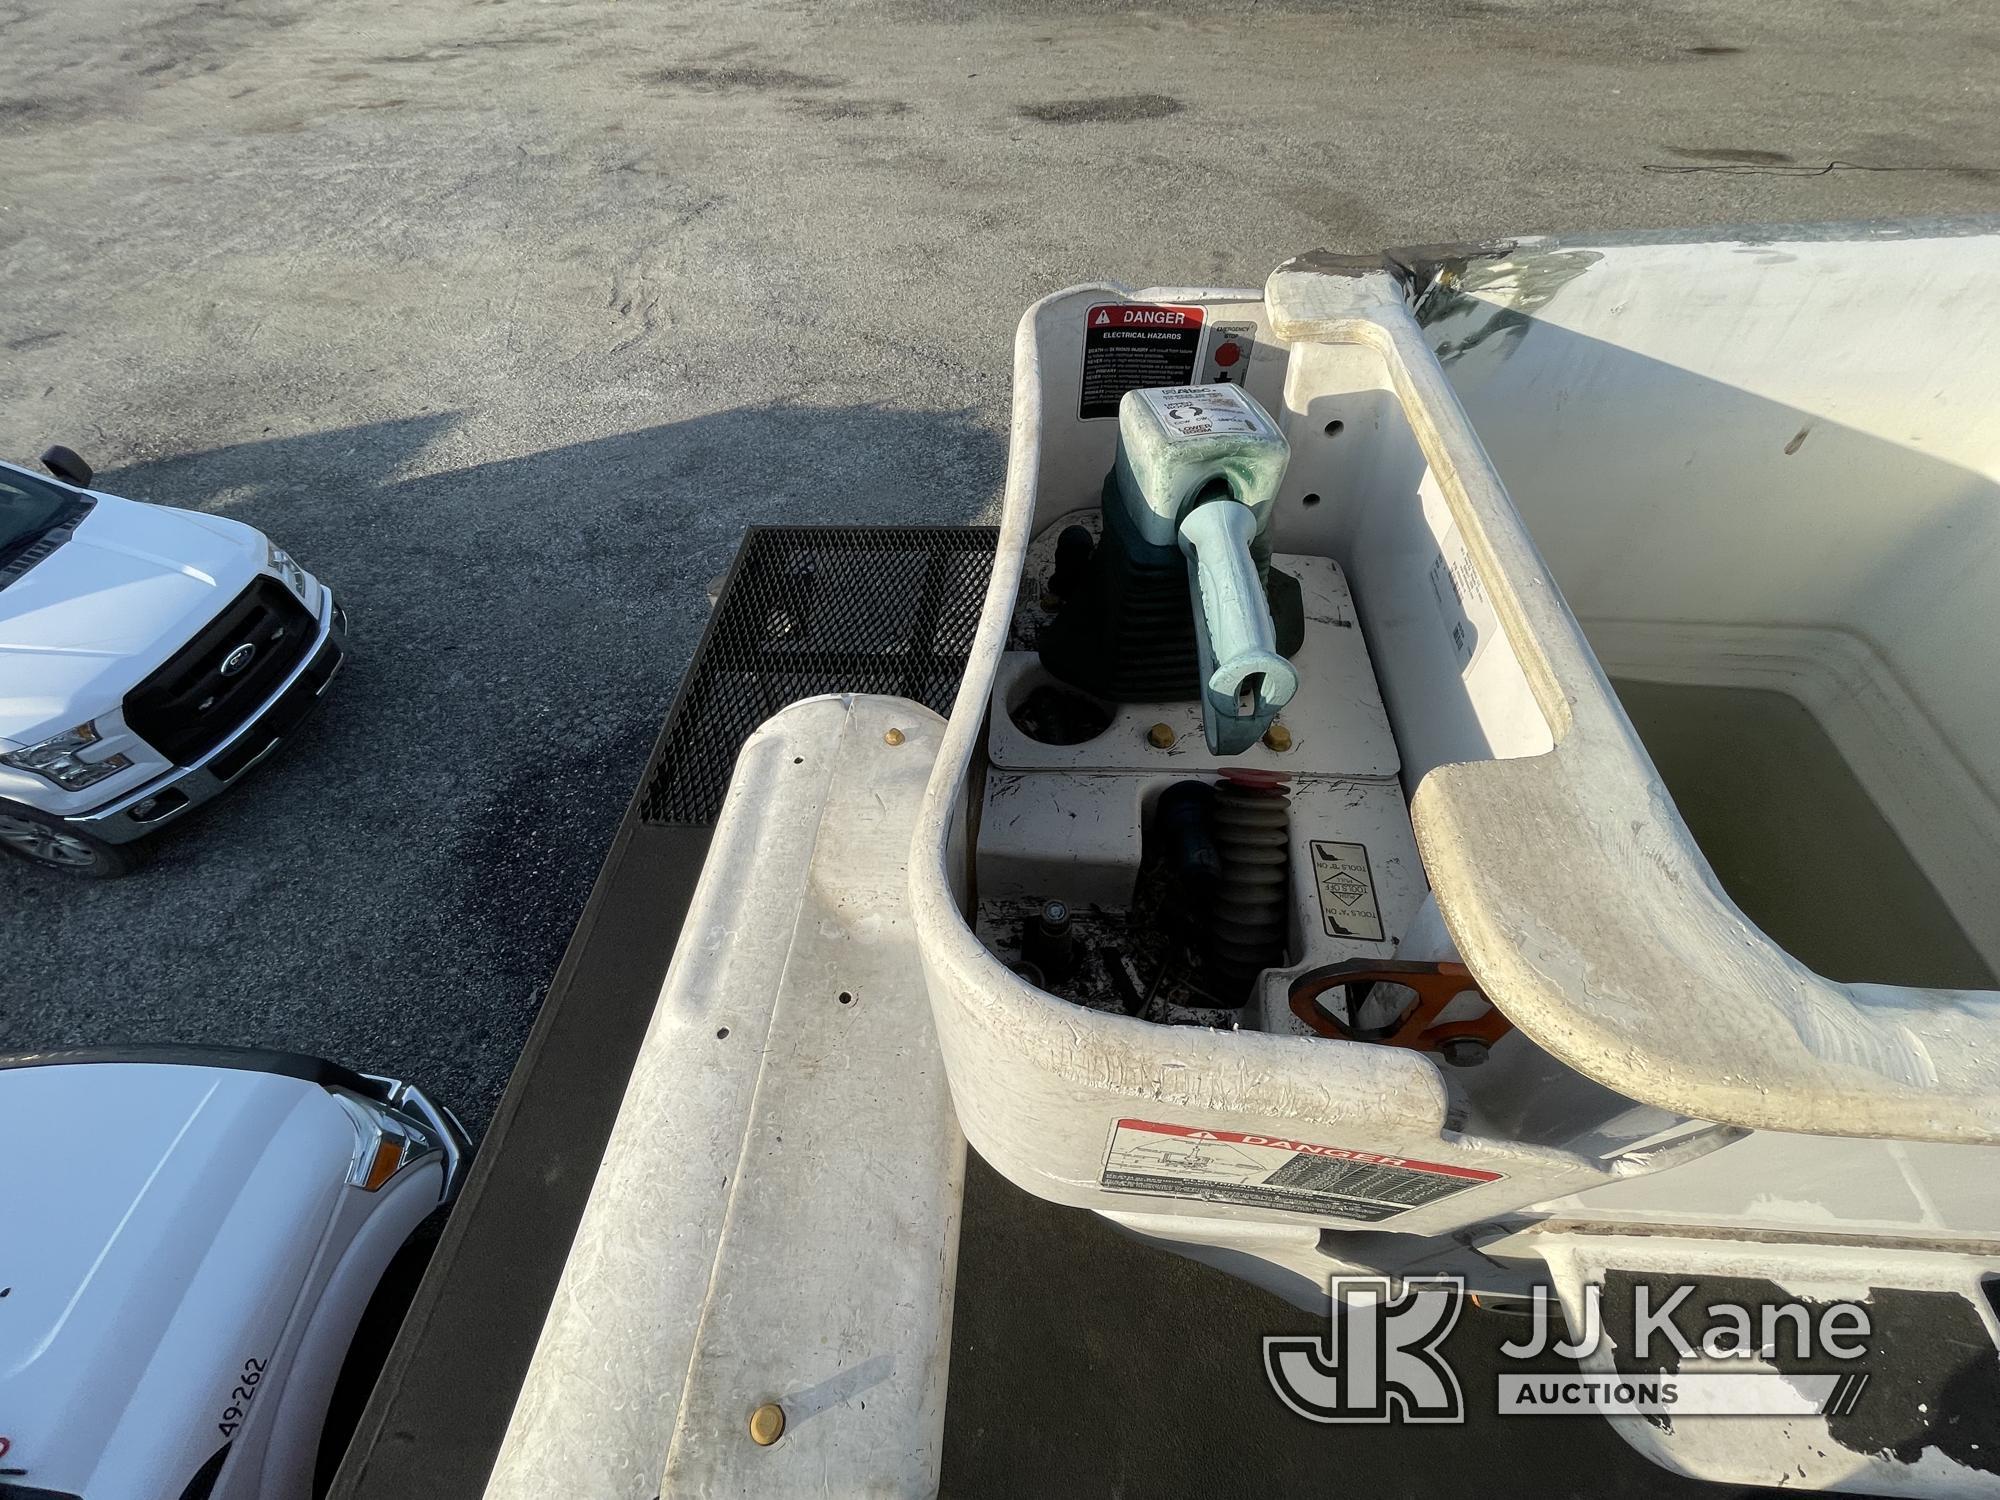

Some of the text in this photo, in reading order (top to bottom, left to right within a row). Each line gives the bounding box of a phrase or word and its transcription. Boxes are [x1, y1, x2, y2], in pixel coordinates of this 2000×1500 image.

[1123, 310, 1186, 325] DANGER
[1103, 331, 1147, 339] ELECTRICAL
[1342, 864, 1367, 873] TOOLS
[1341, 884, 1368, 894] TOOLS
[1325, 907, 1337, 915] ON
[1350, 909, 1376, 919] TOOLS
[1242, 1135, 1407, 1166] DANGER
[218, 1358, 268, 1437] 49-262
